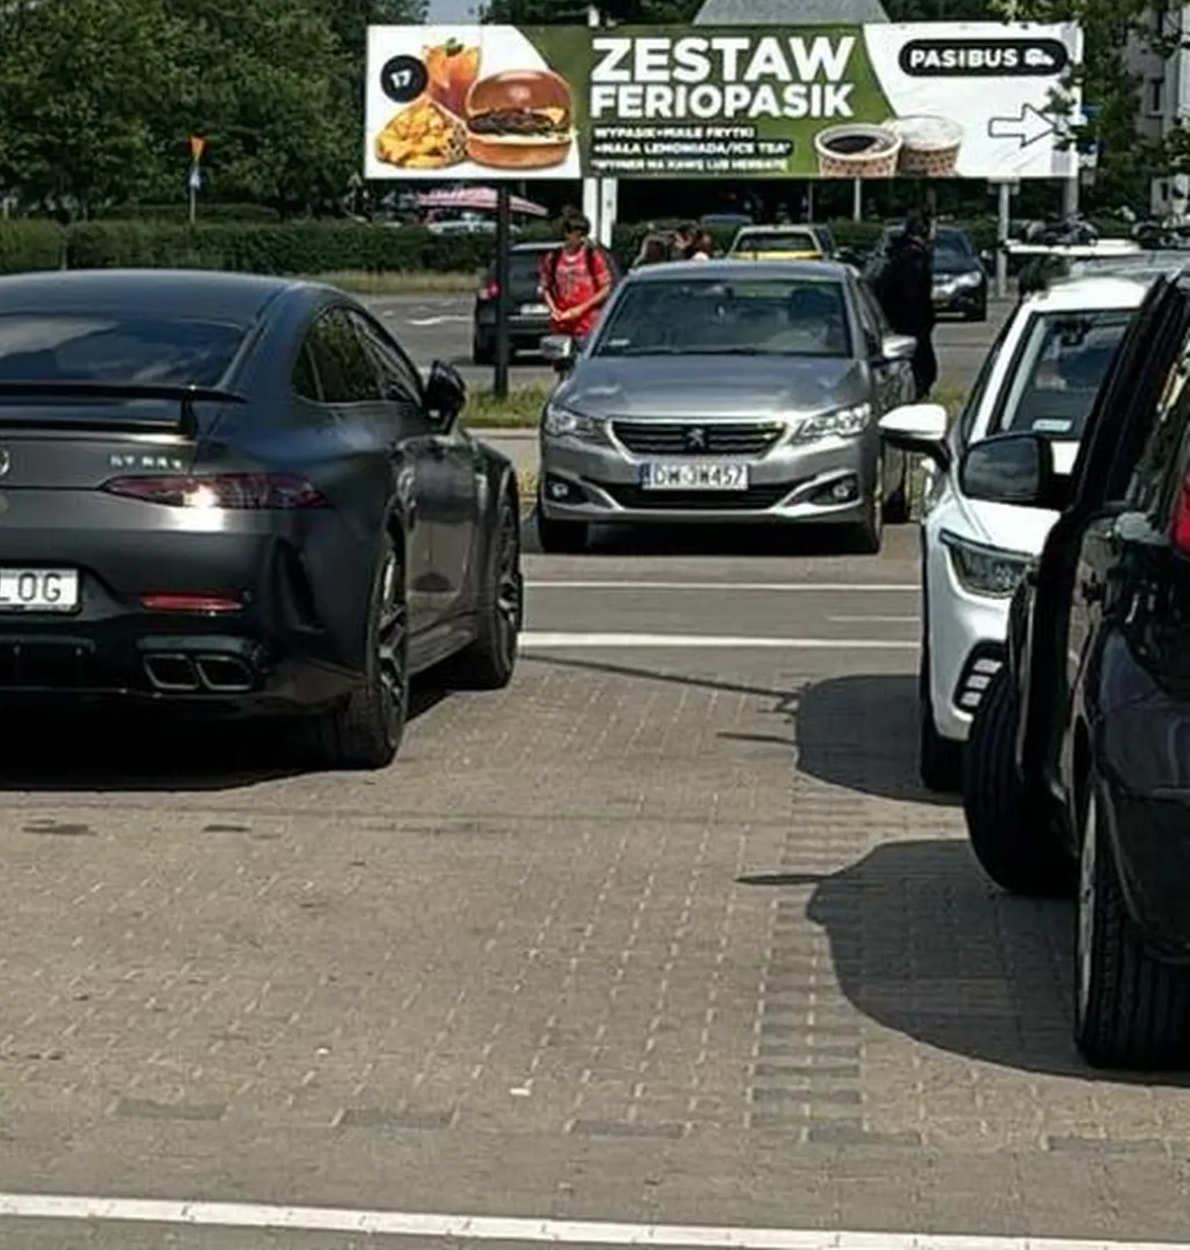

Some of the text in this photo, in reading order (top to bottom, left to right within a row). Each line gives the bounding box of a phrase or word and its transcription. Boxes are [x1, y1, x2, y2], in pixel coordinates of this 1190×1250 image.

[590, 36, 856, 82] ZESTAW
[909, 48, 1018, 68] PASIBUS
[589, 84, 854, 118] FERIOPASIK
